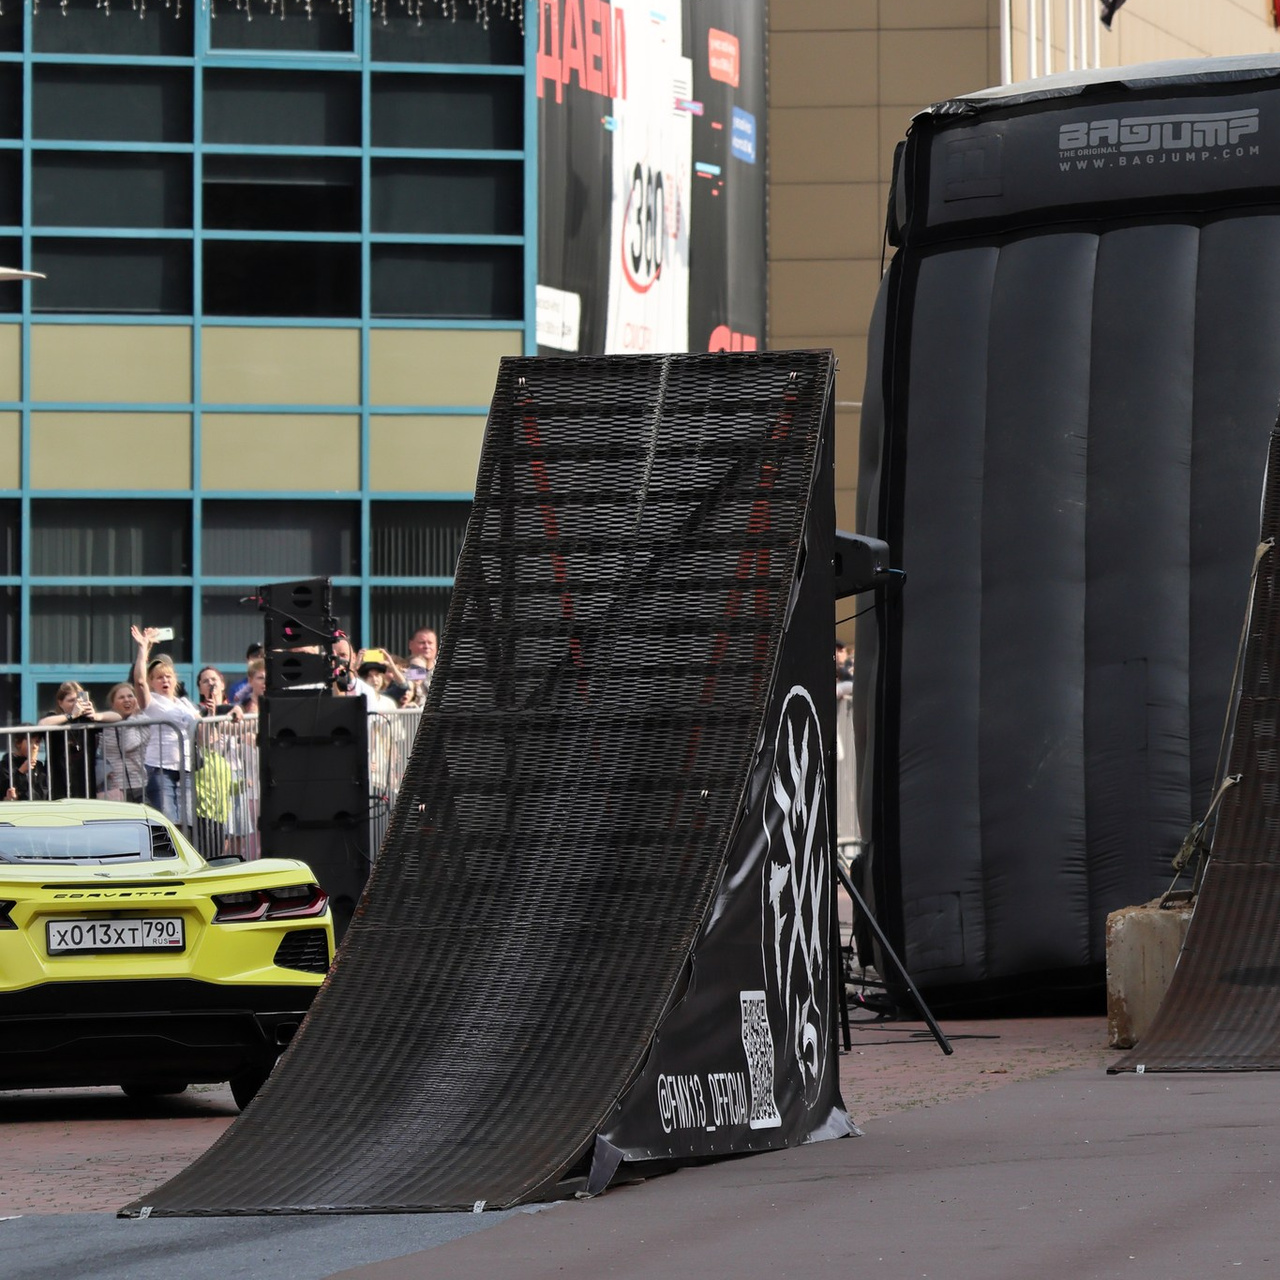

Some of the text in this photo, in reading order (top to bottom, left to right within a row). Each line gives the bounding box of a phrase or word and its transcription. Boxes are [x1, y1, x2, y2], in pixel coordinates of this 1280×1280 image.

[1059, 108, 1260, 153] BAGJUMP
[1059, 146, 1118, 158] THE ORIGINAL
[1059, 145, 1260, 172] WWW.BAGJUMP.COM
[54, 891, 177, 899] CORVETTE
[144, 921, 176, 938] 790
[657, 1072, 748, 1134] @FMX13_OFFICIAL
